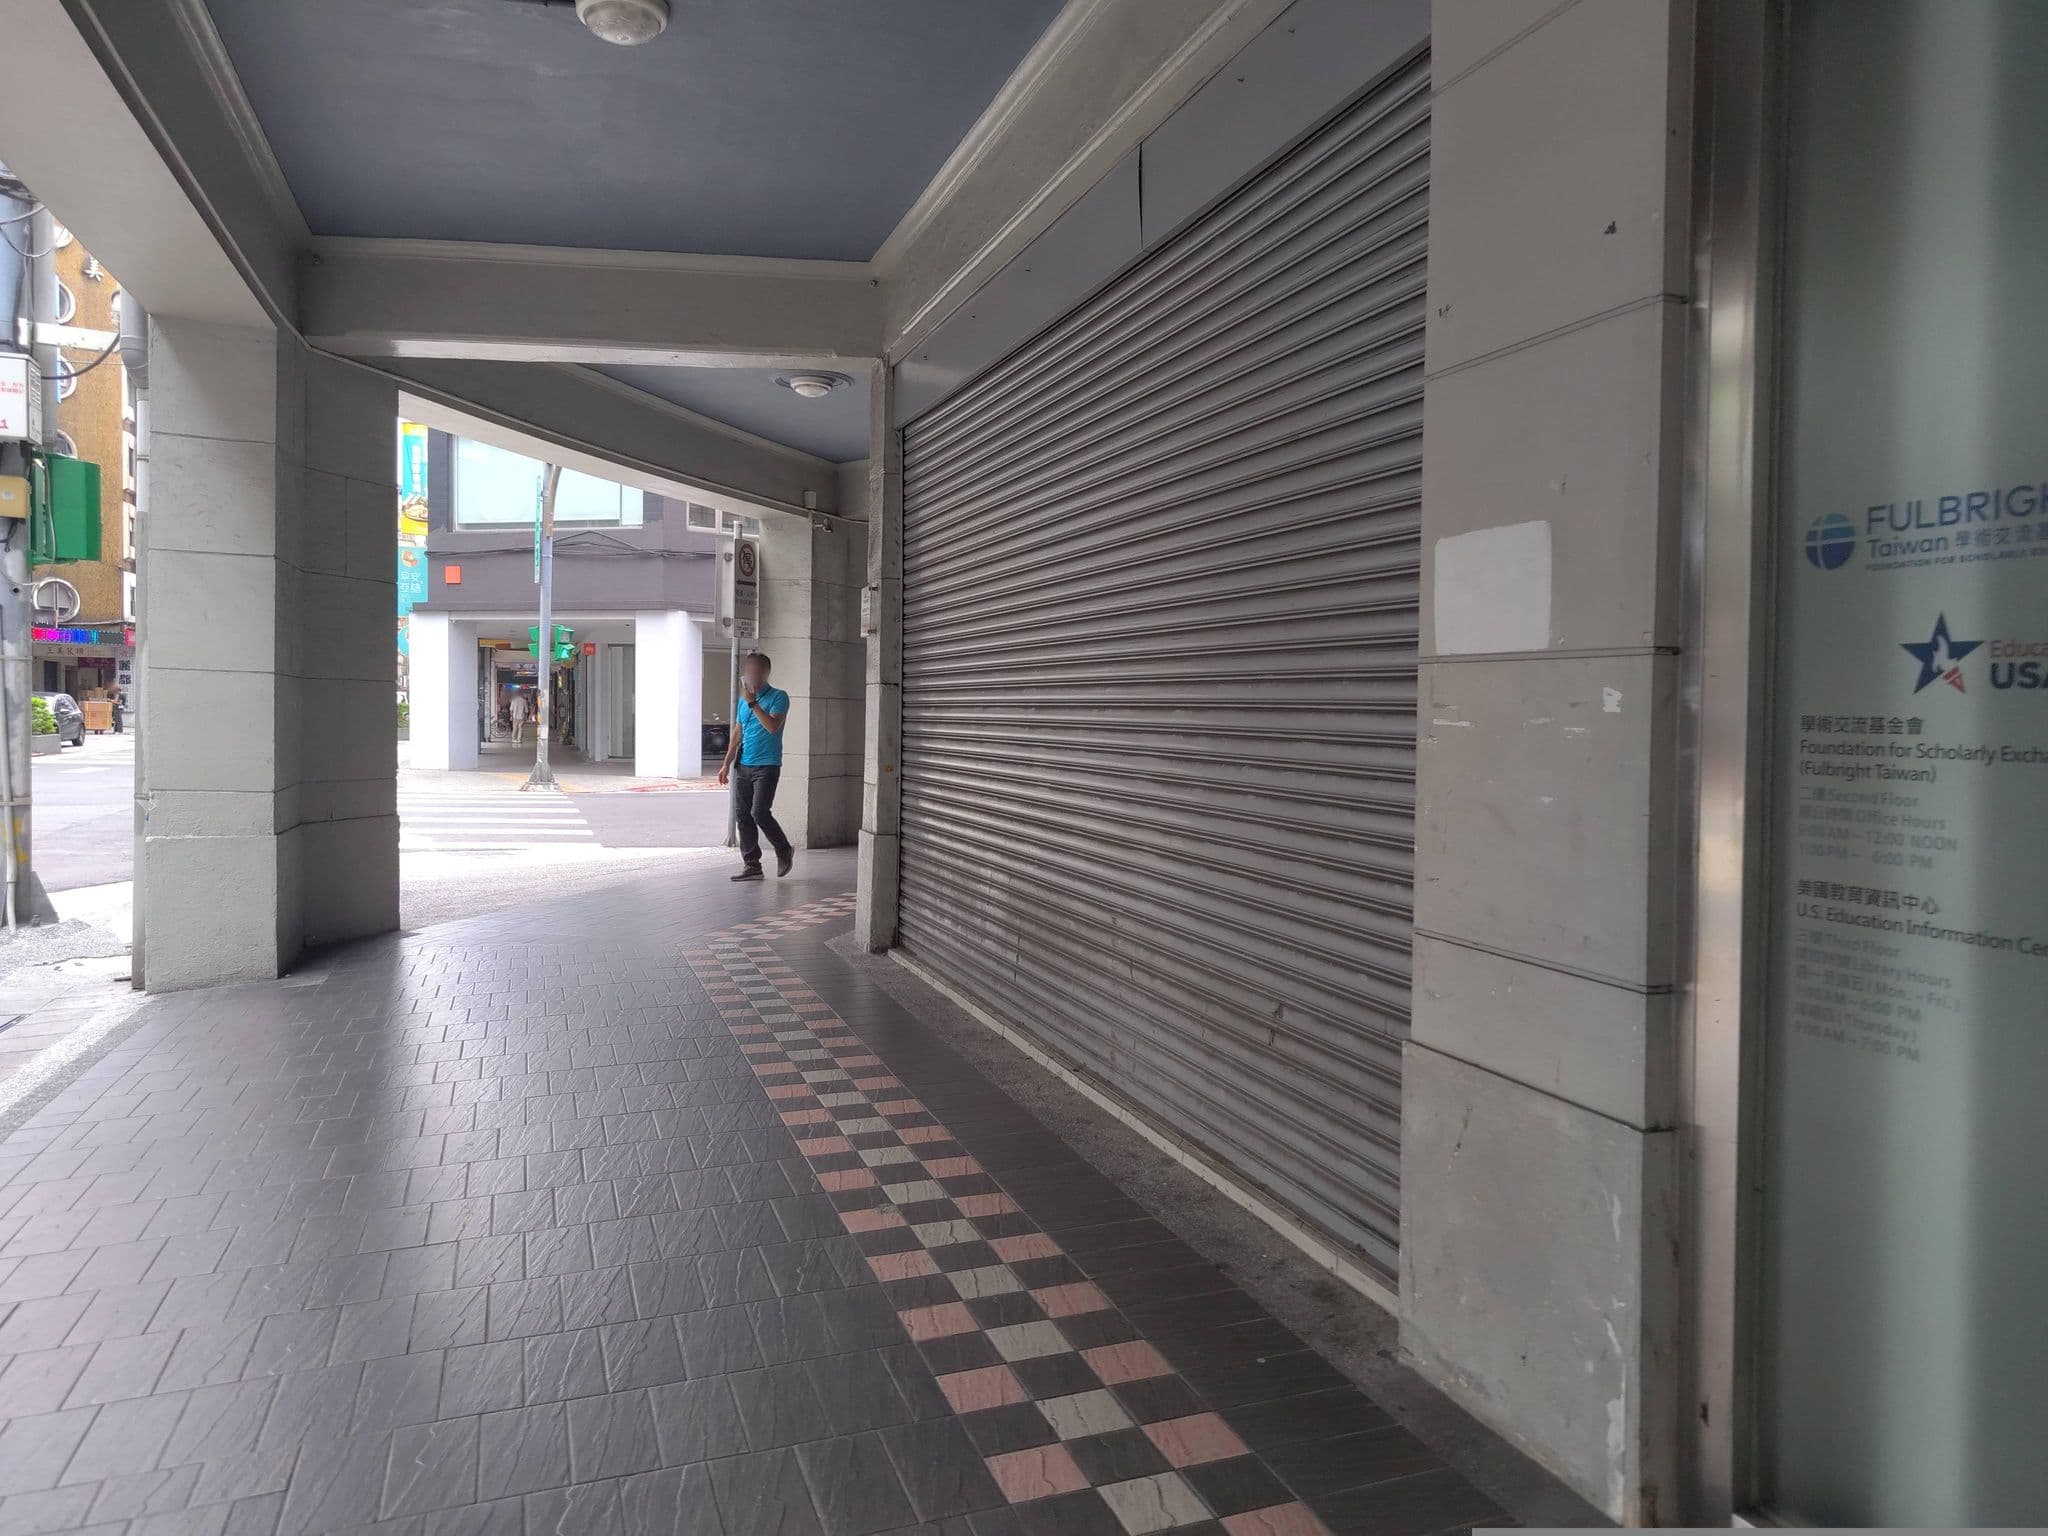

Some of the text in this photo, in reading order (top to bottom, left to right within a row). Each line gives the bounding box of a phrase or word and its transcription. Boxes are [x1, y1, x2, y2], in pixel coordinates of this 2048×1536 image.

[84, 255, 105, 282] 美
[1867, 535, 1949, 559] Taiwan
[1990, 661, 2048, 690] US
[1800, 715, 1924, 735] 學術交流基金會
[1800, 739, 1888, 758] Foundation
[1889, 741, 1912, 758] for
[1915, 743, 1996, 766] Scholarly
[1800, 760, 1937, 784] (Fulbright Taiwan)
[1796, 879, 1940, 916] 美國教育資訊中心
[1826, 906, 1904, 933] Education
[1905, 919, 2012, 950] Information
